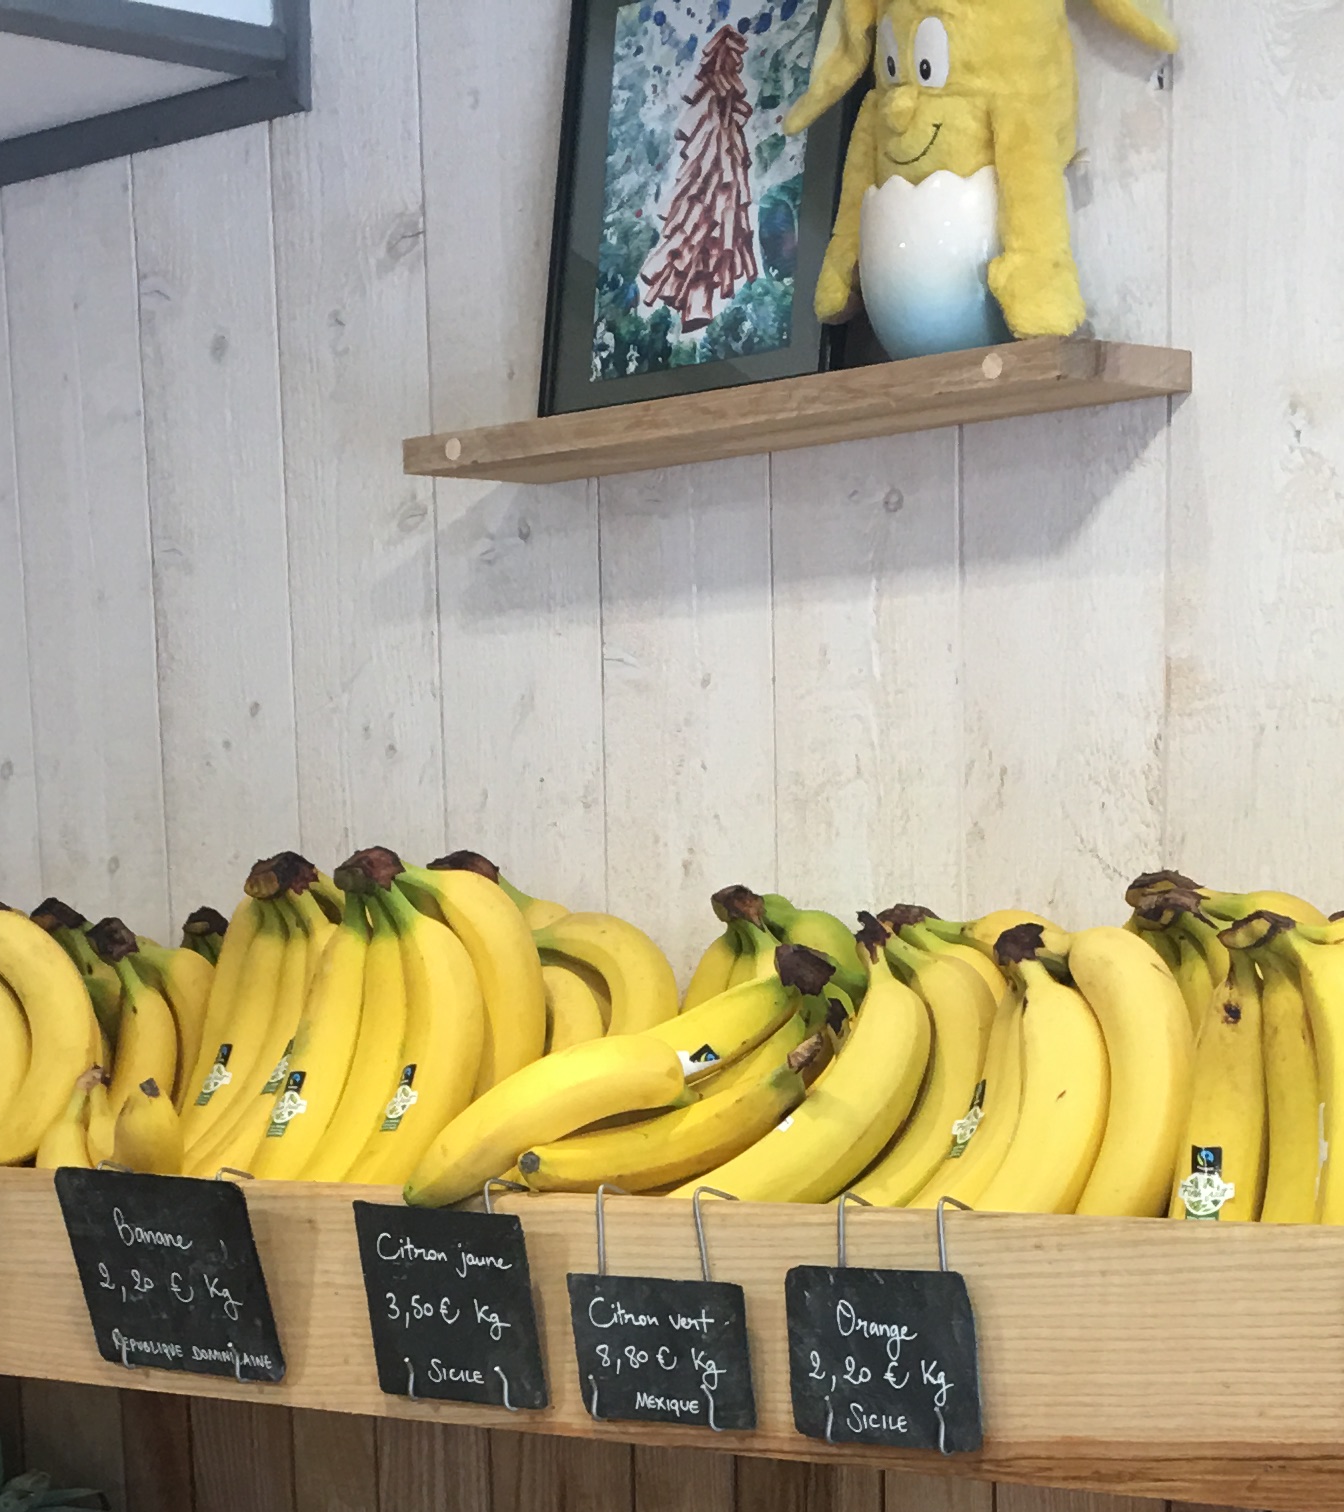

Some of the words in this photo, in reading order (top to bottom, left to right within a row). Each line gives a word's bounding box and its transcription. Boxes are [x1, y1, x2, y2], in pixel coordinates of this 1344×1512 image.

[113, 1207, 193, 1250] Banane
[376, 1232, 448, 1262] Citron
[456, 1243, 512, 1278] jaune
[588, 1297, 659, 1328] Citron
[669, 1309, 715, 1333] vert
[836, 1300, 918, 1361] Orange
[192, 1345, 273, 1369] DOMINIAINE
[427, 1358, 485, 1384] SICILE
[921, 1360, 954, 1407] Kg
[635, 1391, 701, 1417] MEXIQUE
[847, 1402, 908, 1433] SICILE
